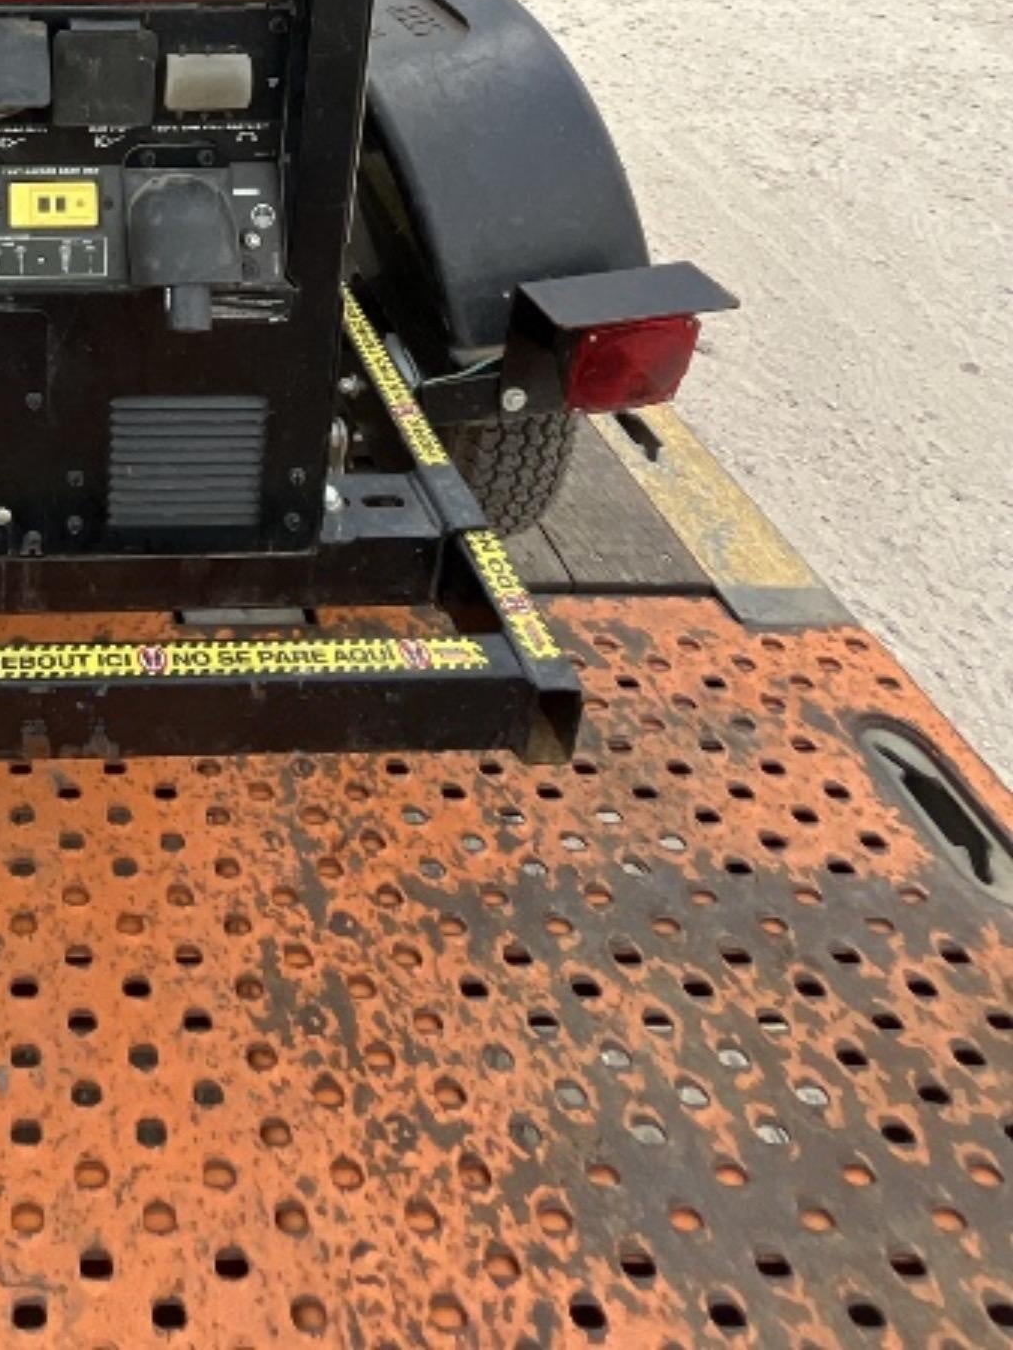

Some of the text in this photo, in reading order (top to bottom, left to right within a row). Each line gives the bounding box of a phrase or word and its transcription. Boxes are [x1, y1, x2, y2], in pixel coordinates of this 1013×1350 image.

[97, 653, 131, 666] ICI
[173, 649, 210, 666] NO
[257, 648, 328, 665] PARE
[334, 647, 396, 663] AQUI
